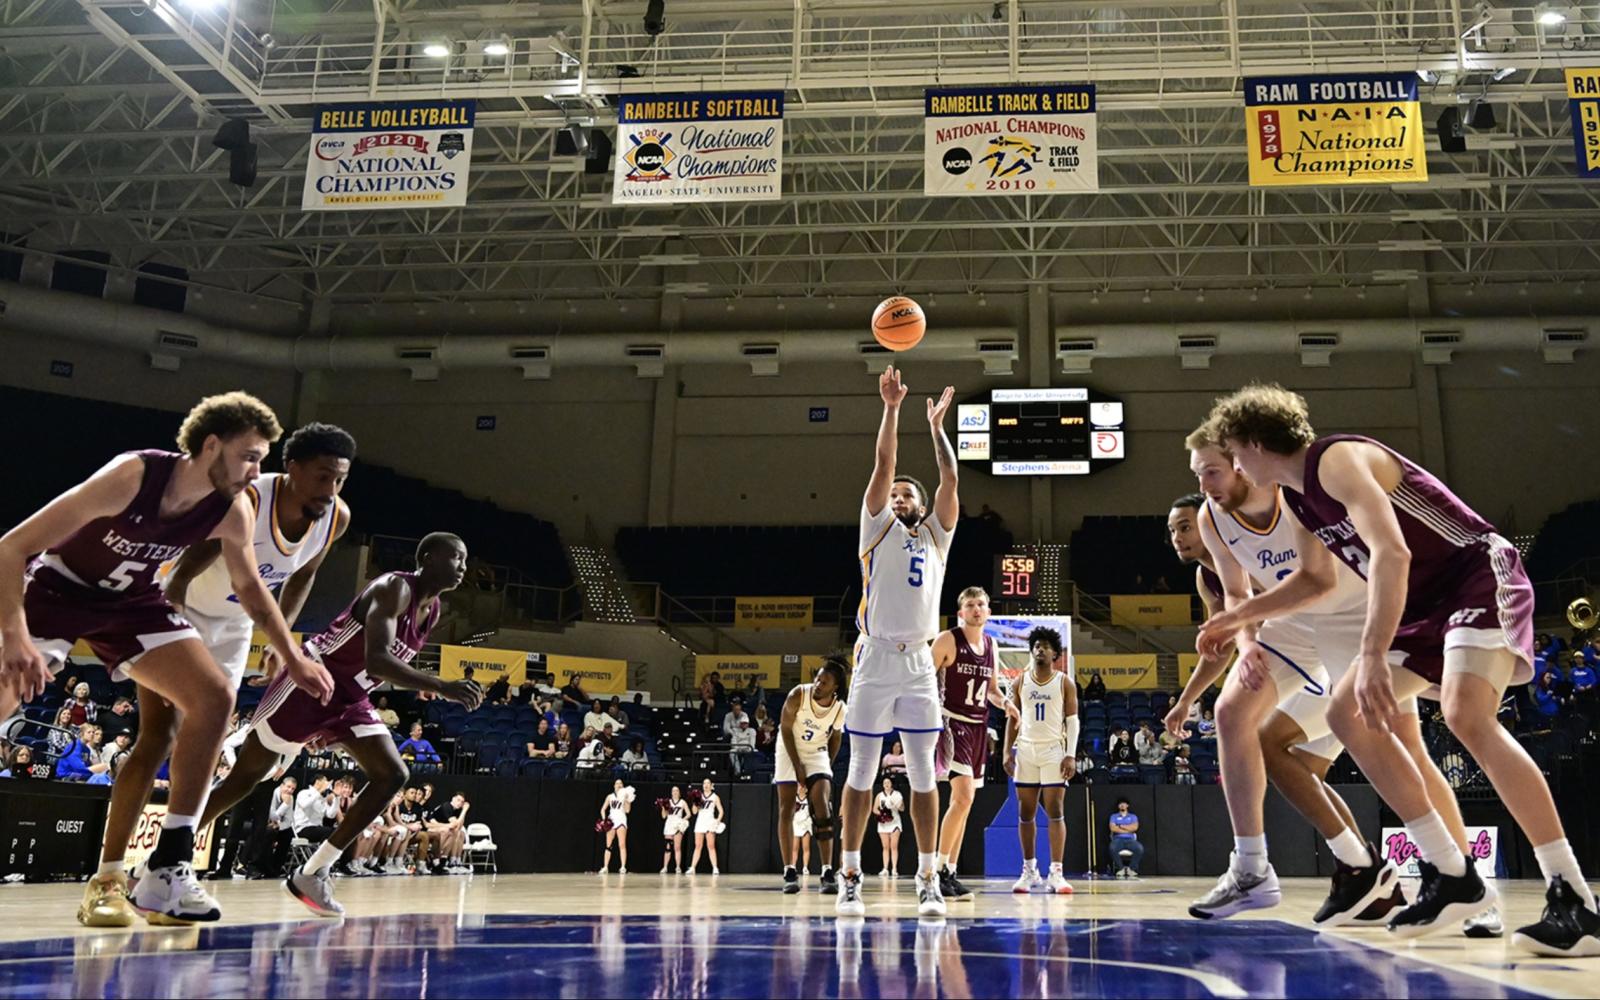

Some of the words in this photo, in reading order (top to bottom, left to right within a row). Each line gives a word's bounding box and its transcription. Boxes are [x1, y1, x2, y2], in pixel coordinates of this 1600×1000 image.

[1256, 84, 1298, 102] RAM
[1310, 81, 1408, 100] FOOTBALL
[1573, 76, 1600, 94] RA
[625, 101, 700, 120] RAMBELLE
[706, 99, 779, 117] SOFTBALL
[931, 96, 993, 114] RAMBELLE
[998, 94, 1038, 112] TRACK
[1042, 94, 1052, 110] &
[1056, 92, 1089, 110] FIELD
[320, 110, 365, 128] BELLE
[371, 108, 468, 128] VOLLEYBALL
[638, 128, 664, 139] 2004
[680, 125, 775, 150] National
[936, 120, 1002, 144] NATIONAL
[1007, 118, 1086, 141] CHAMPIONS
[1296, 126, 1406, 150] National
[367, 135, 418, 148] 2020
[1050, 146, 1078, 156] TRACK
[337, 157, 442, 174] NATIONAL
[637, 156, 663, 165] NCAA
[678, 154, 777, 178] Champions
[946, 160, 972, 168] NCAA
[1049, 158, 1056, 167] &
[1058, 156, 1080, 167] FIELD
[1274, 152, 1414, 176] Champions
[316, 172, 456, 194] CHAMPIONS
[986, 180, 1036, 190] 2010
[622, 188, 662, 198] ANGELO
[670, 188, 700, 196] STATE
[709, 186, 774, 194] UNIVERSITY
[1002, 463, 1050, 472] Stephens
[102, 529, 145, 557] WEST
[908, 556, 924, 587] 5
[1002, 558, 1034, 572] 15:58
[98, 560, 148, 592] 5
[1002, 572, 1030, 595] 30
[486, 662, 506, 672] FAMILY
[957, 663, 976, 674] WEST
[965, 678, 988, 708] 14
[1029, 691, 1052, 700] Rams
[1035, 703, 1046, 721] 11
[802, 730, 814, 741] 3
[32, 764, 50, 776] POSS
[56, 820, 84, 833] GUEST
[12, 838, 18, 849] P
[30, 838, 36, 849] P
